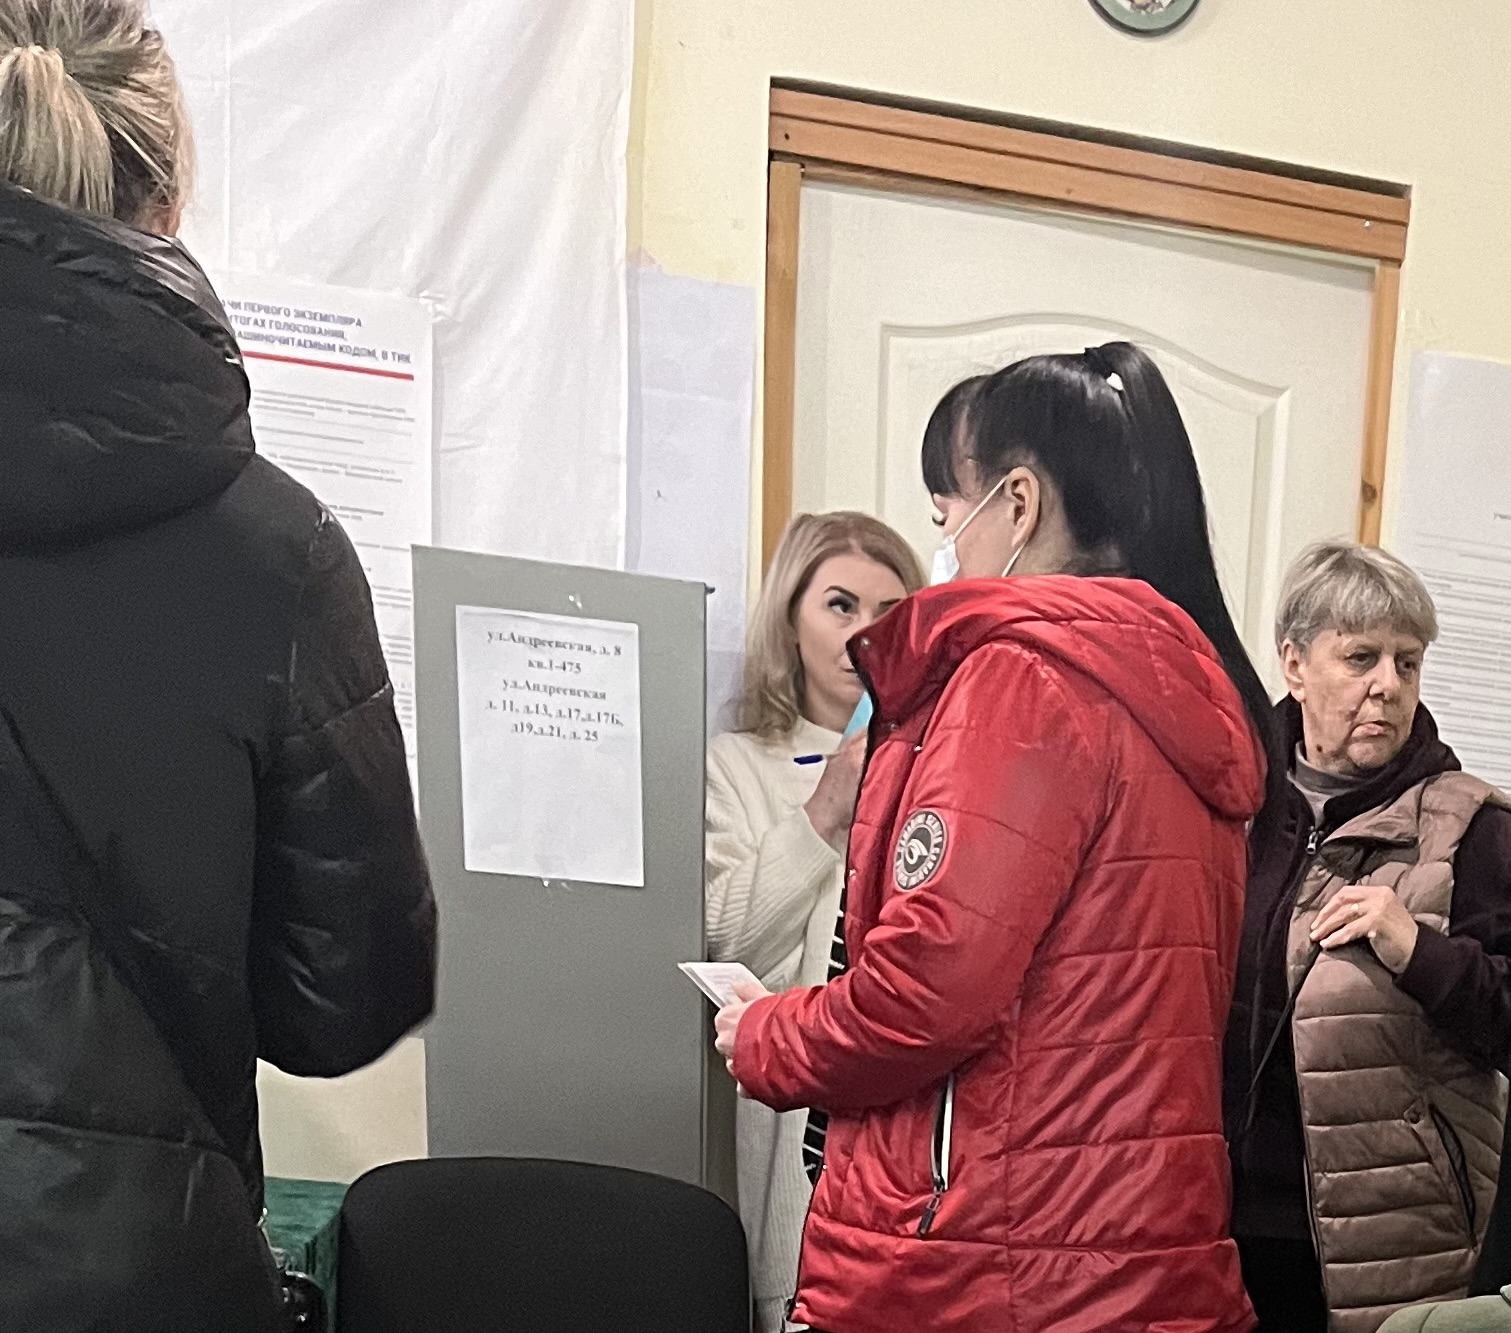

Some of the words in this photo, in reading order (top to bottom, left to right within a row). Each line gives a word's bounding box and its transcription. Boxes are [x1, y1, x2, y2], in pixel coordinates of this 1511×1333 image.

[614, 644, 622, 656] 8
[528, 659, 582, 674] кв.1-475
[584, 729, 599, 742] 25
